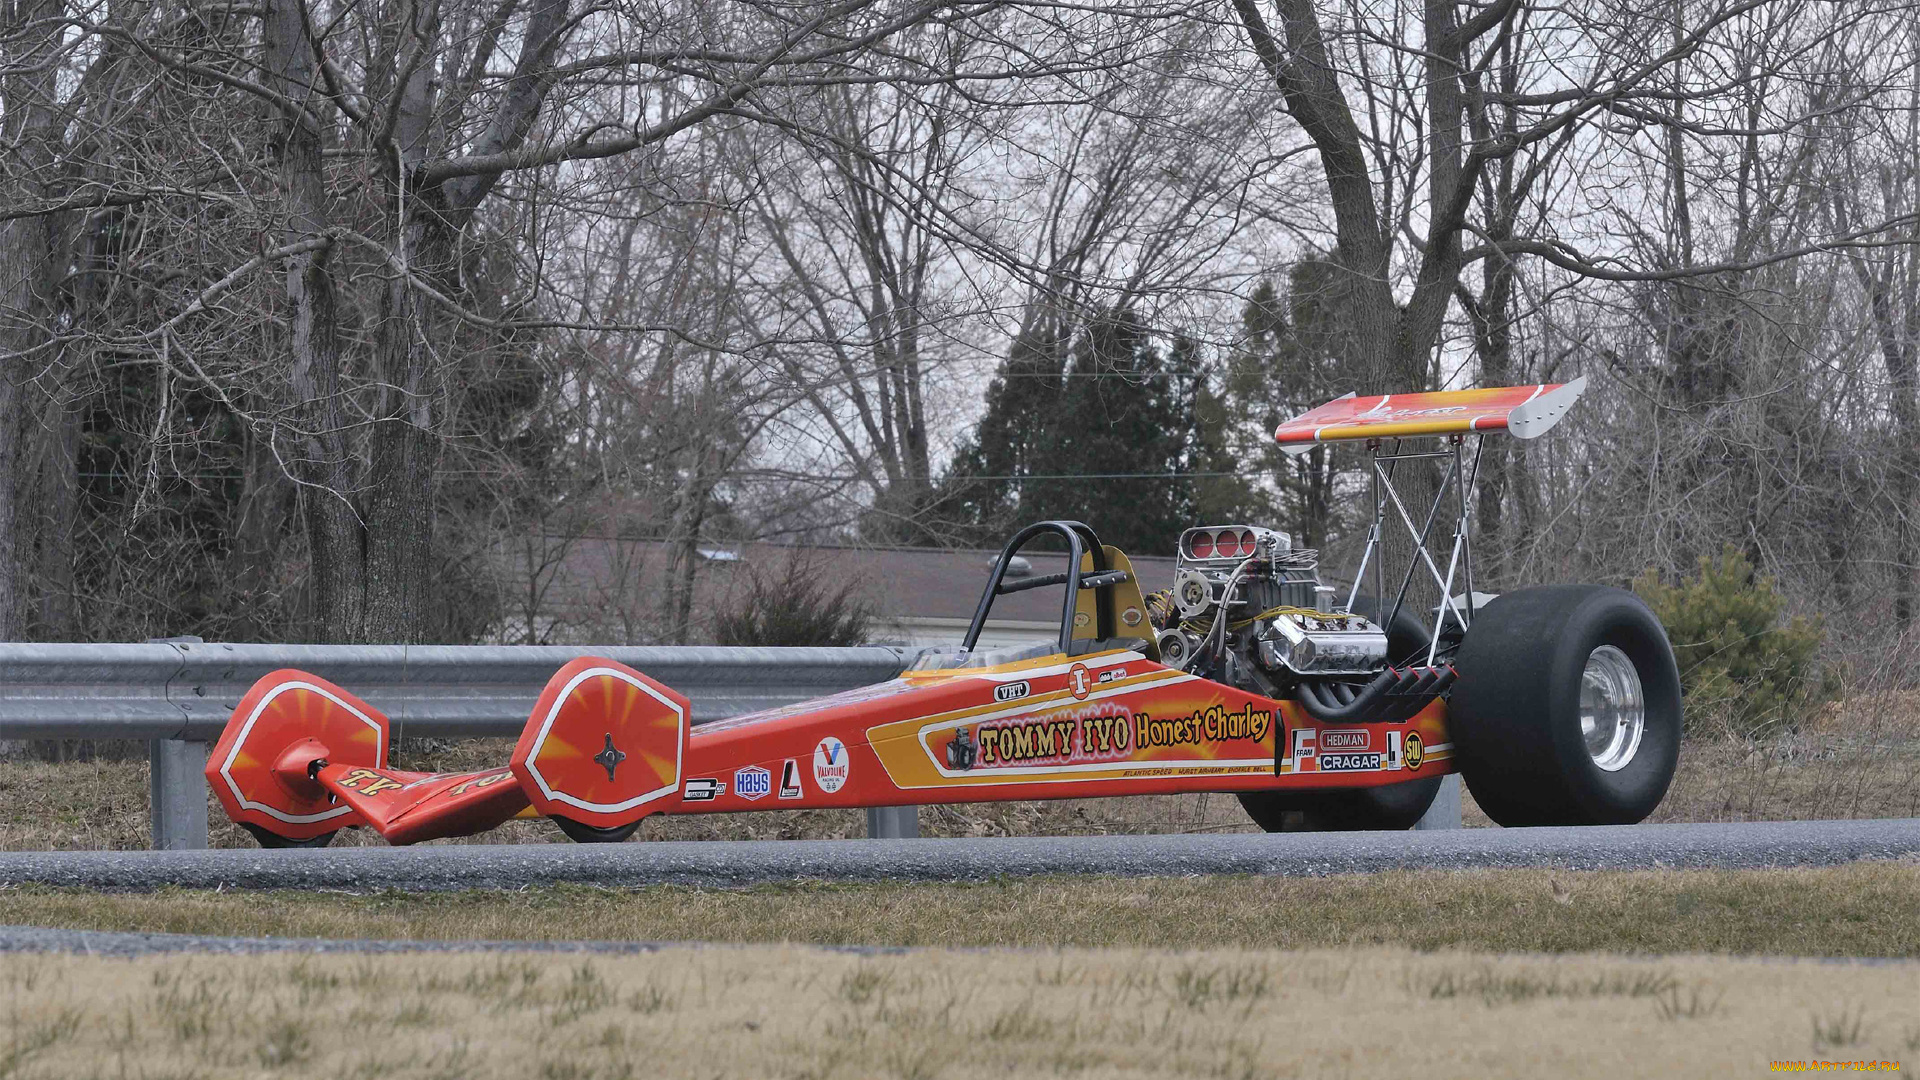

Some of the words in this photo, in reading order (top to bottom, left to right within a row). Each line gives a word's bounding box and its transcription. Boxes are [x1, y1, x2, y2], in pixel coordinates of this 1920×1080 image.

[1000, 684, 1023, 699] VHT
[1134, 710, 1203, 749] Honest
[1204, 702, 1271, 743] Charley
[979, 720, 1075, 762] TOMMY
[1082, 716, 1129, 753] IVO
[1327, 734, 1364, 746] HEDMAN
[1296, 749, 1313, 757] FRAM
[1407, 740, 1421, 760] SW
[1322, 755, 1380, 769] CRAGAR
[817, 765, 846, 778] VALVOLINE
[1122, 769, 1152, 777] ATLANTIC
